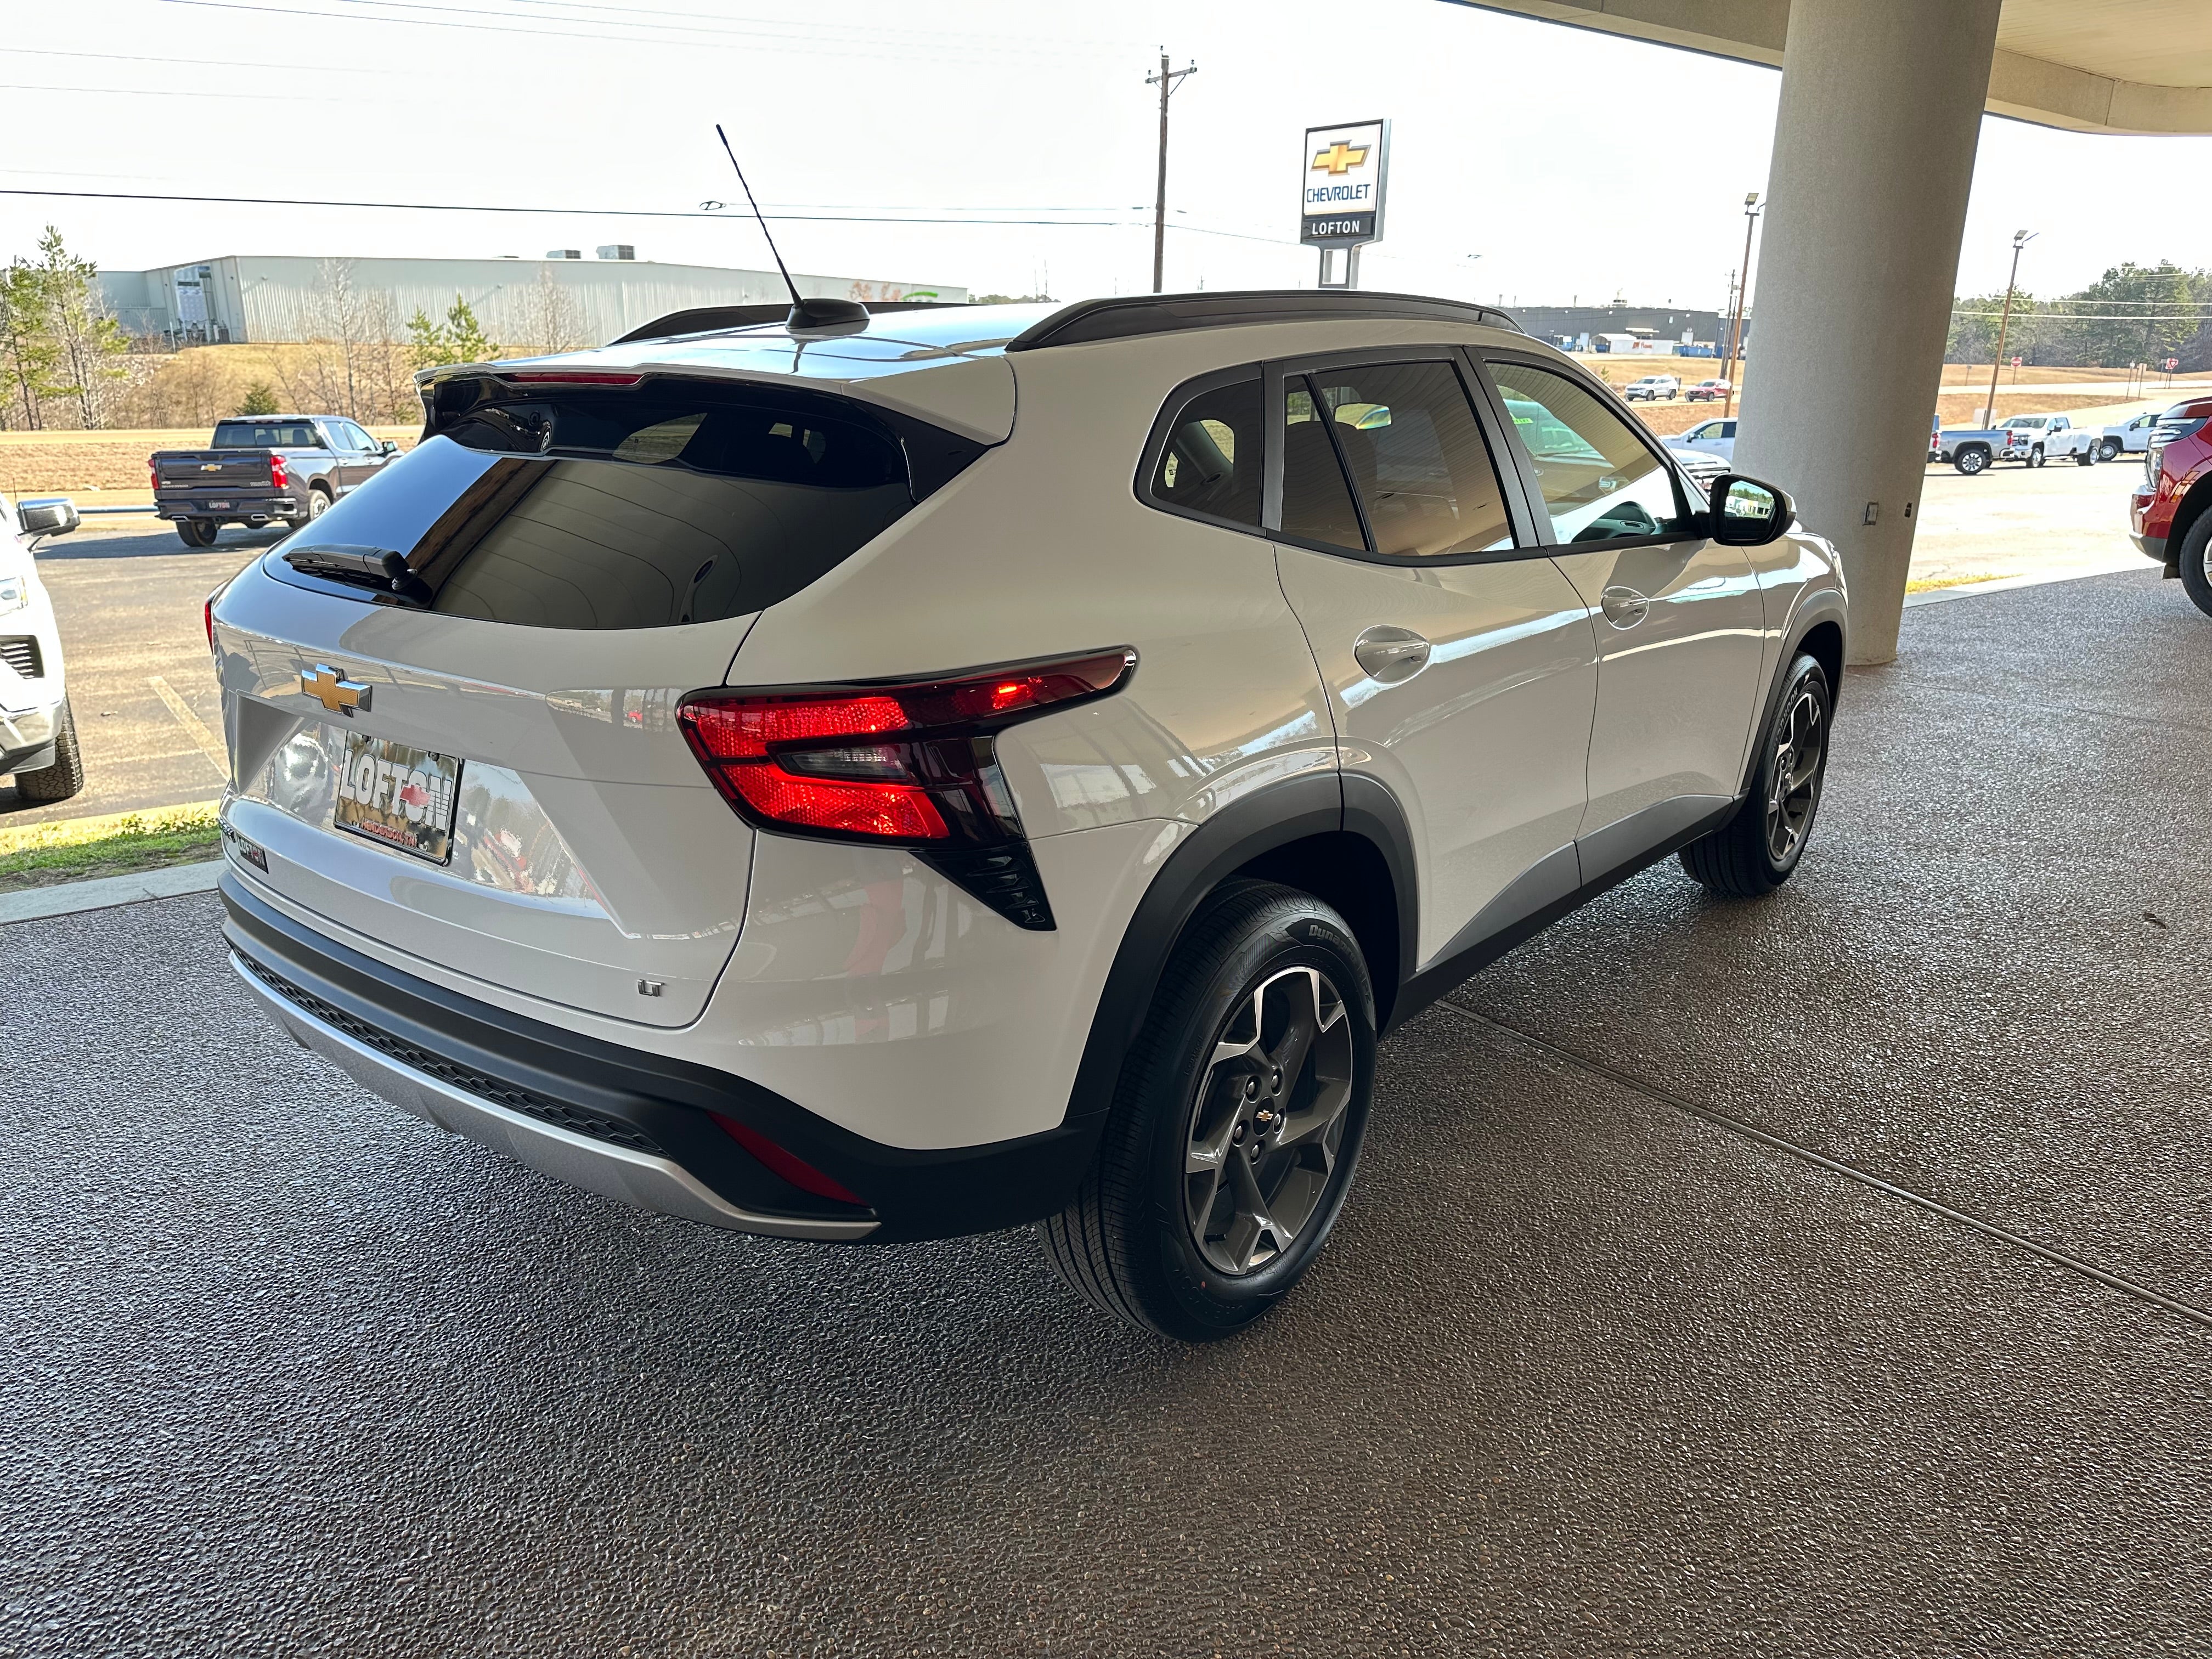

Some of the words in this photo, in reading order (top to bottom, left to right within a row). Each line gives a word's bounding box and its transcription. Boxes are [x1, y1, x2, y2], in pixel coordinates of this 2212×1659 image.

[1306, 184, 1371, 203] CHEVROLET
[1312, 221, 1360, 235] LOFTON
[339, 748, 452, 831] LOFTON
[637, 979, 665, 997] LT
